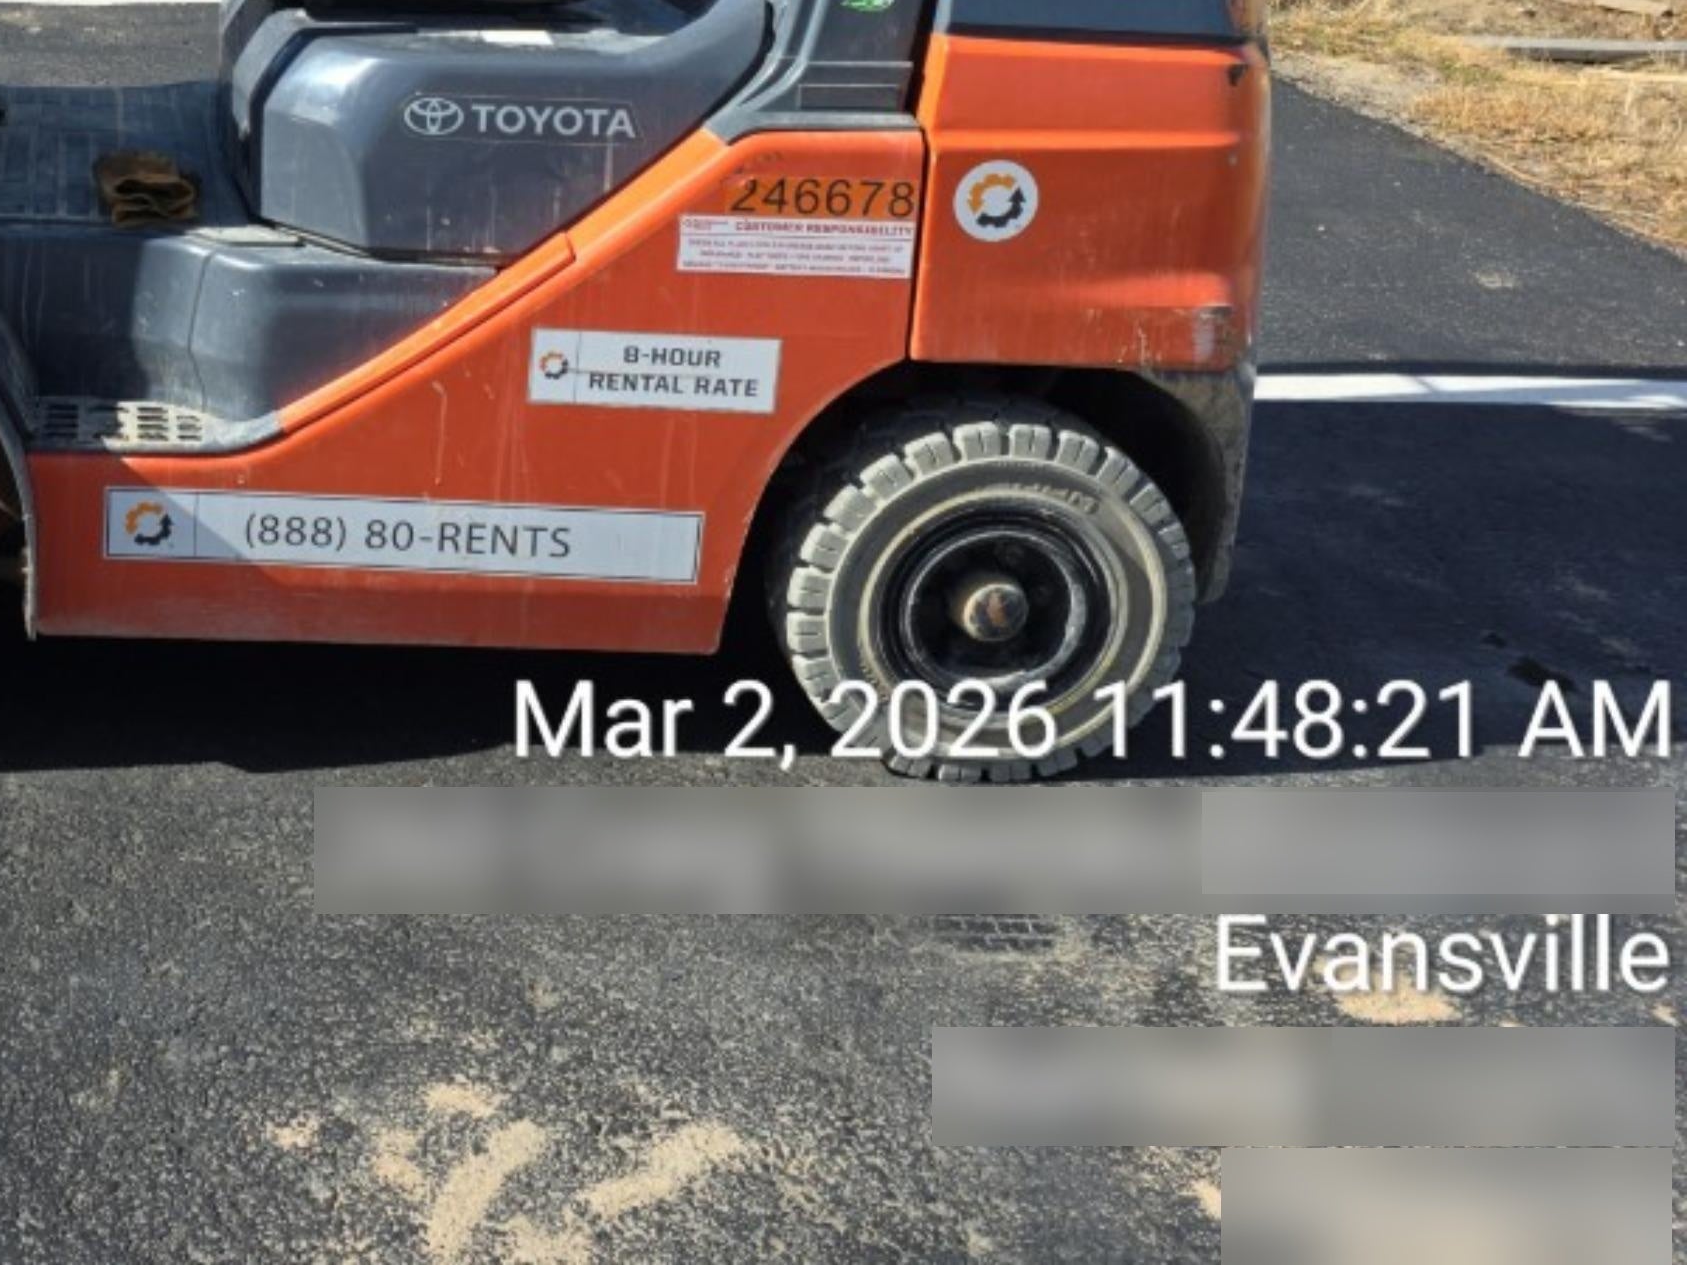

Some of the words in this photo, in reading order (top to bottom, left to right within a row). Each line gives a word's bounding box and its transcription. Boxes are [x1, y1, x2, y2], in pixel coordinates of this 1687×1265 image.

[472, 102, 636, 139] TOYOTA
[730, 177, 915, 218] 246678
[623, 345, 721, 368] 8-HOUR
[589, 372, 683, 395] RENTAL
[694, 377, 758, 398] RATE
[245, 513, 347, 552] (888)
[365, 519, 571, 558] 80-RENTS
